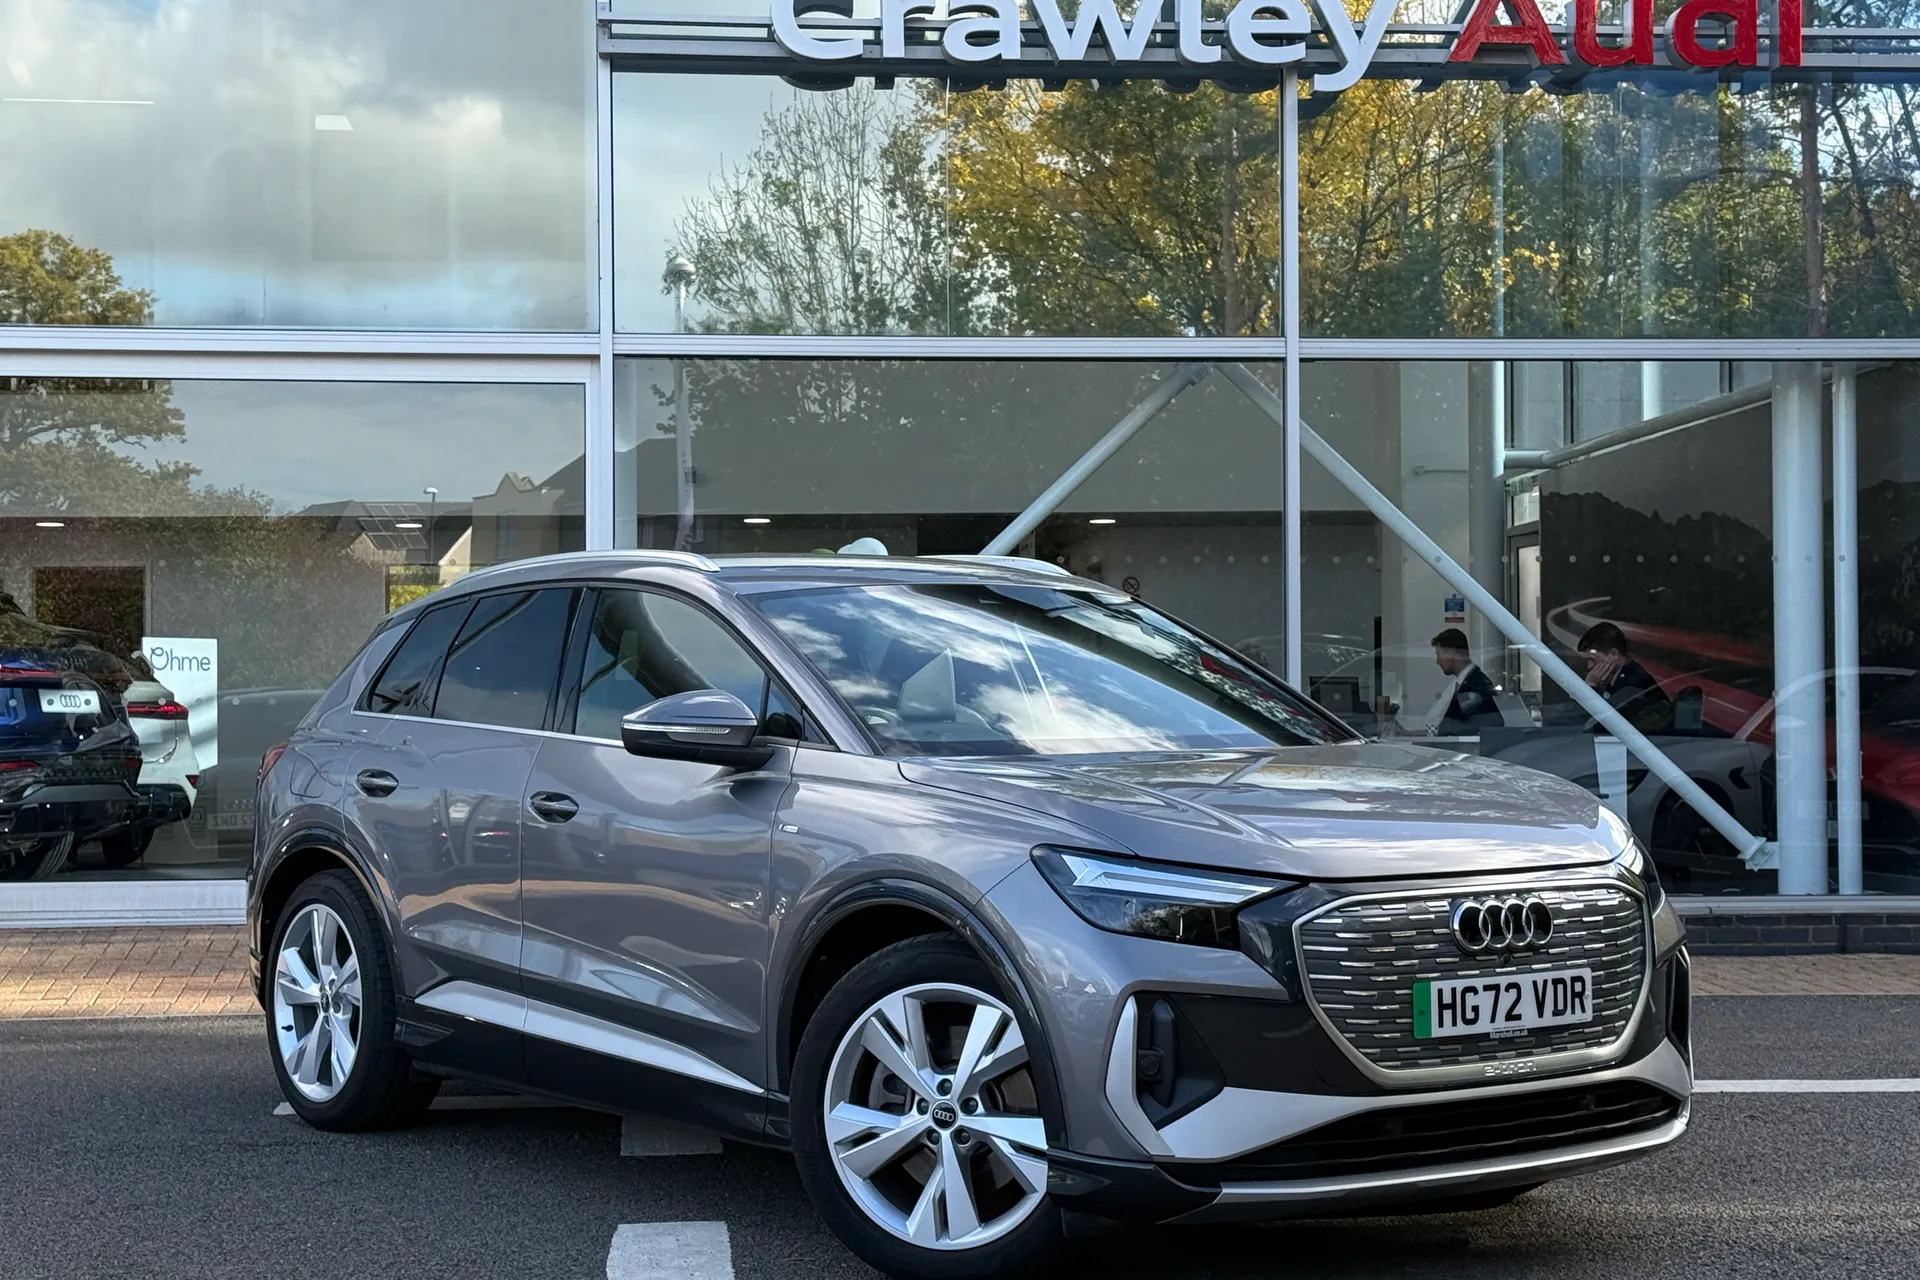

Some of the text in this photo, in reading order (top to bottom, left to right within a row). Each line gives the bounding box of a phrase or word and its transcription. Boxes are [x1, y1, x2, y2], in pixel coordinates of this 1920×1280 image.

[770, 0, 1803, 92] Crawley Audi
[149, 646, 211, 671] Ohme
[1437, 975, 1587, 1029] HG72 VDR
